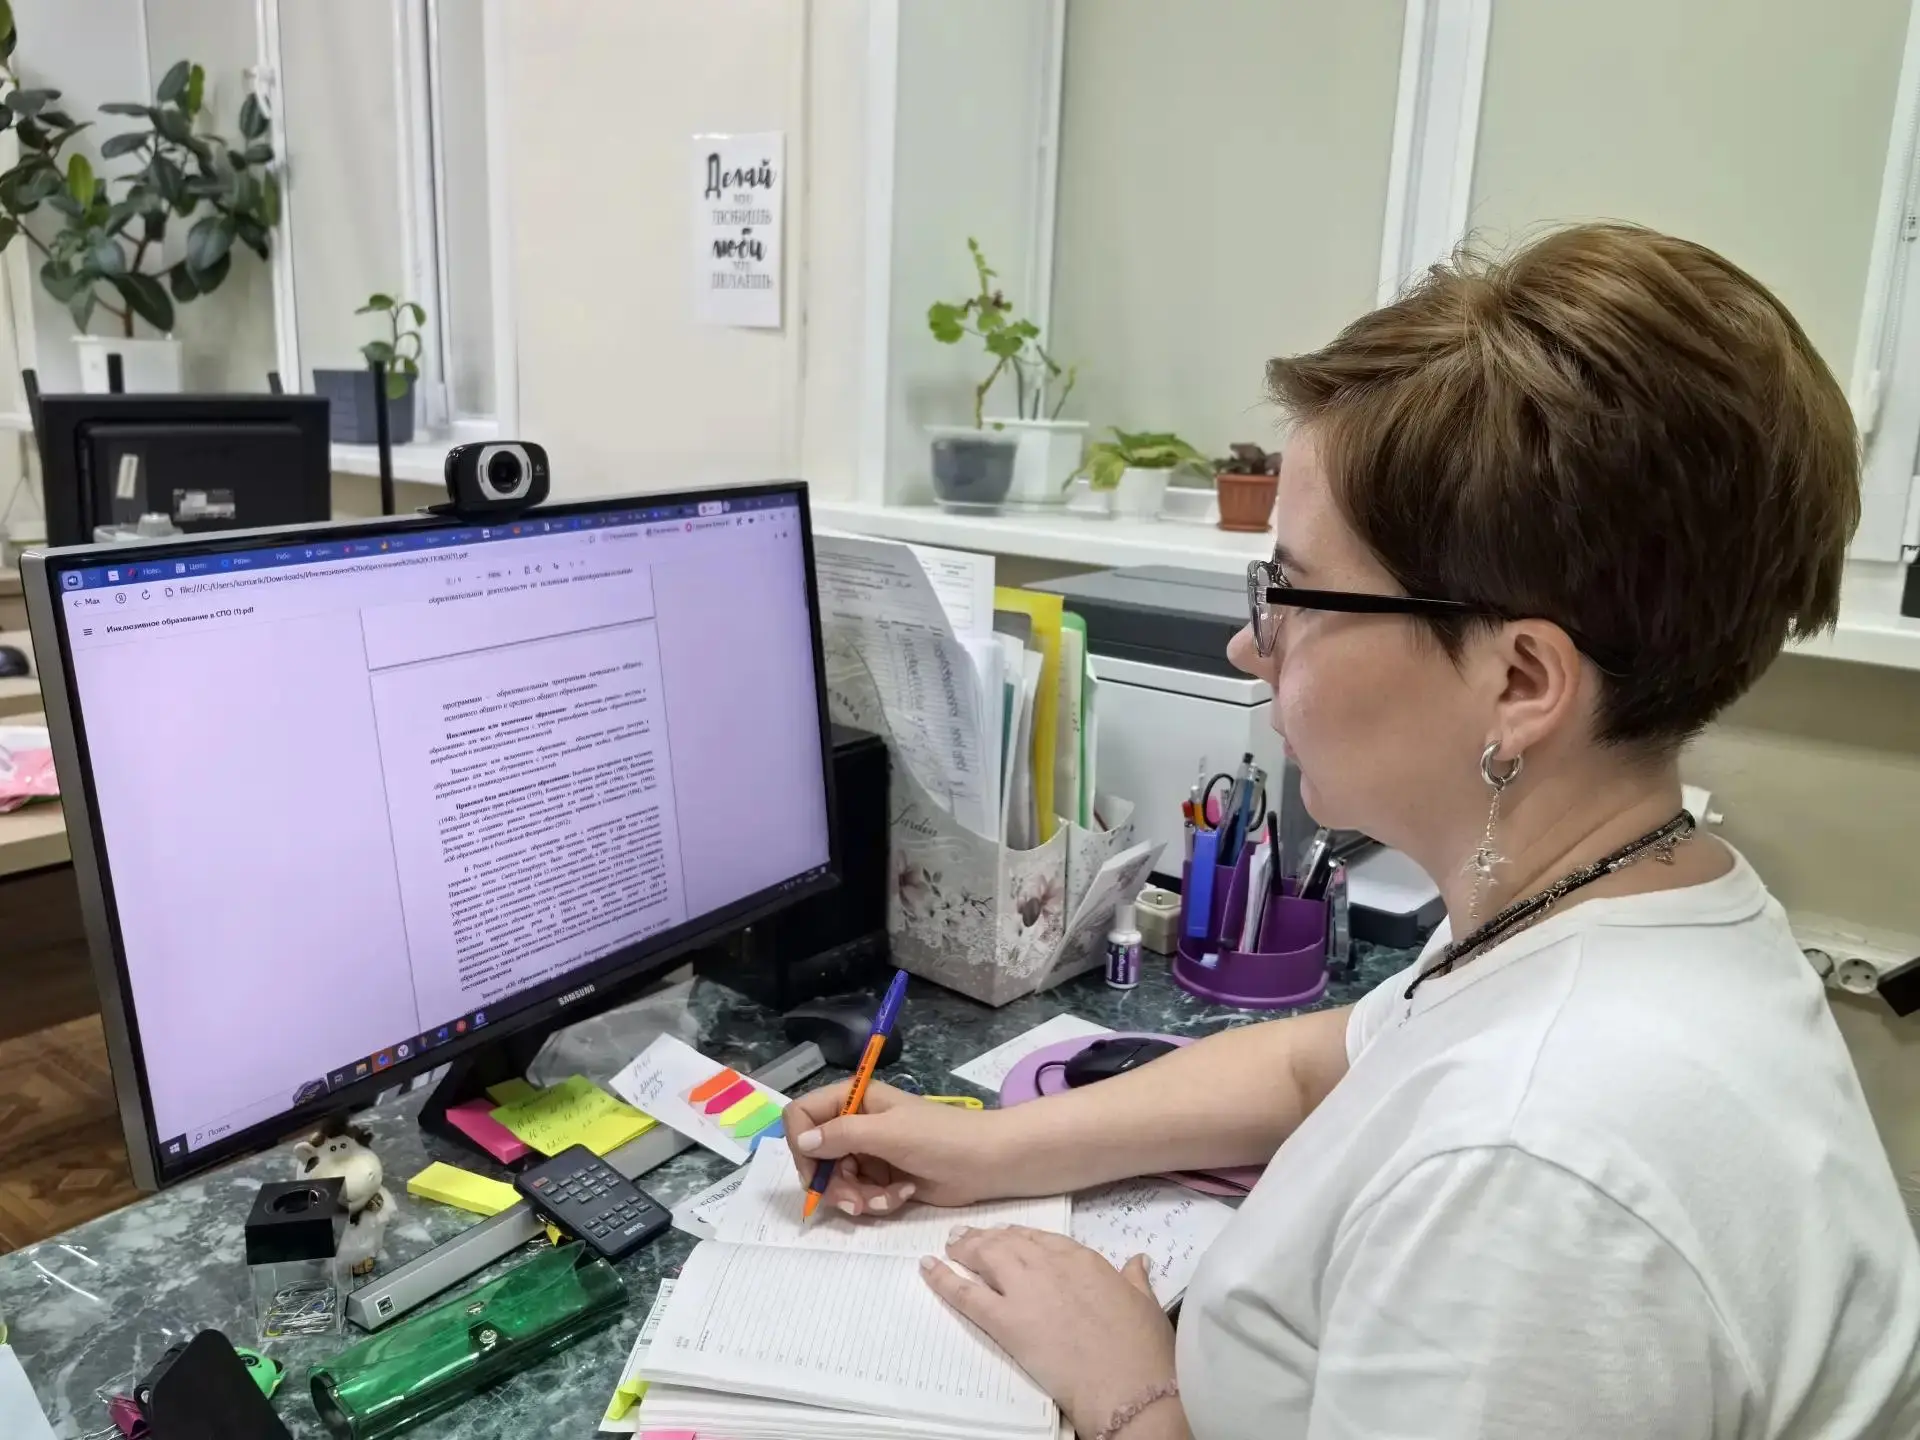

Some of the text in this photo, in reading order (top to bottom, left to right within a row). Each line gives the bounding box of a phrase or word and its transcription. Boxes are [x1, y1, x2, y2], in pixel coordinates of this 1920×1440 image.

[705, 152, 776, 200] Делай
[106, 620, 159, 632] Инклюзивное
[161, 614, 208, 625] образование
[215, 609, 231, 617] СПО
[558, 984, 595, 1006] SAMSUNG
[207, 1124, 230, 1137] Поиск
